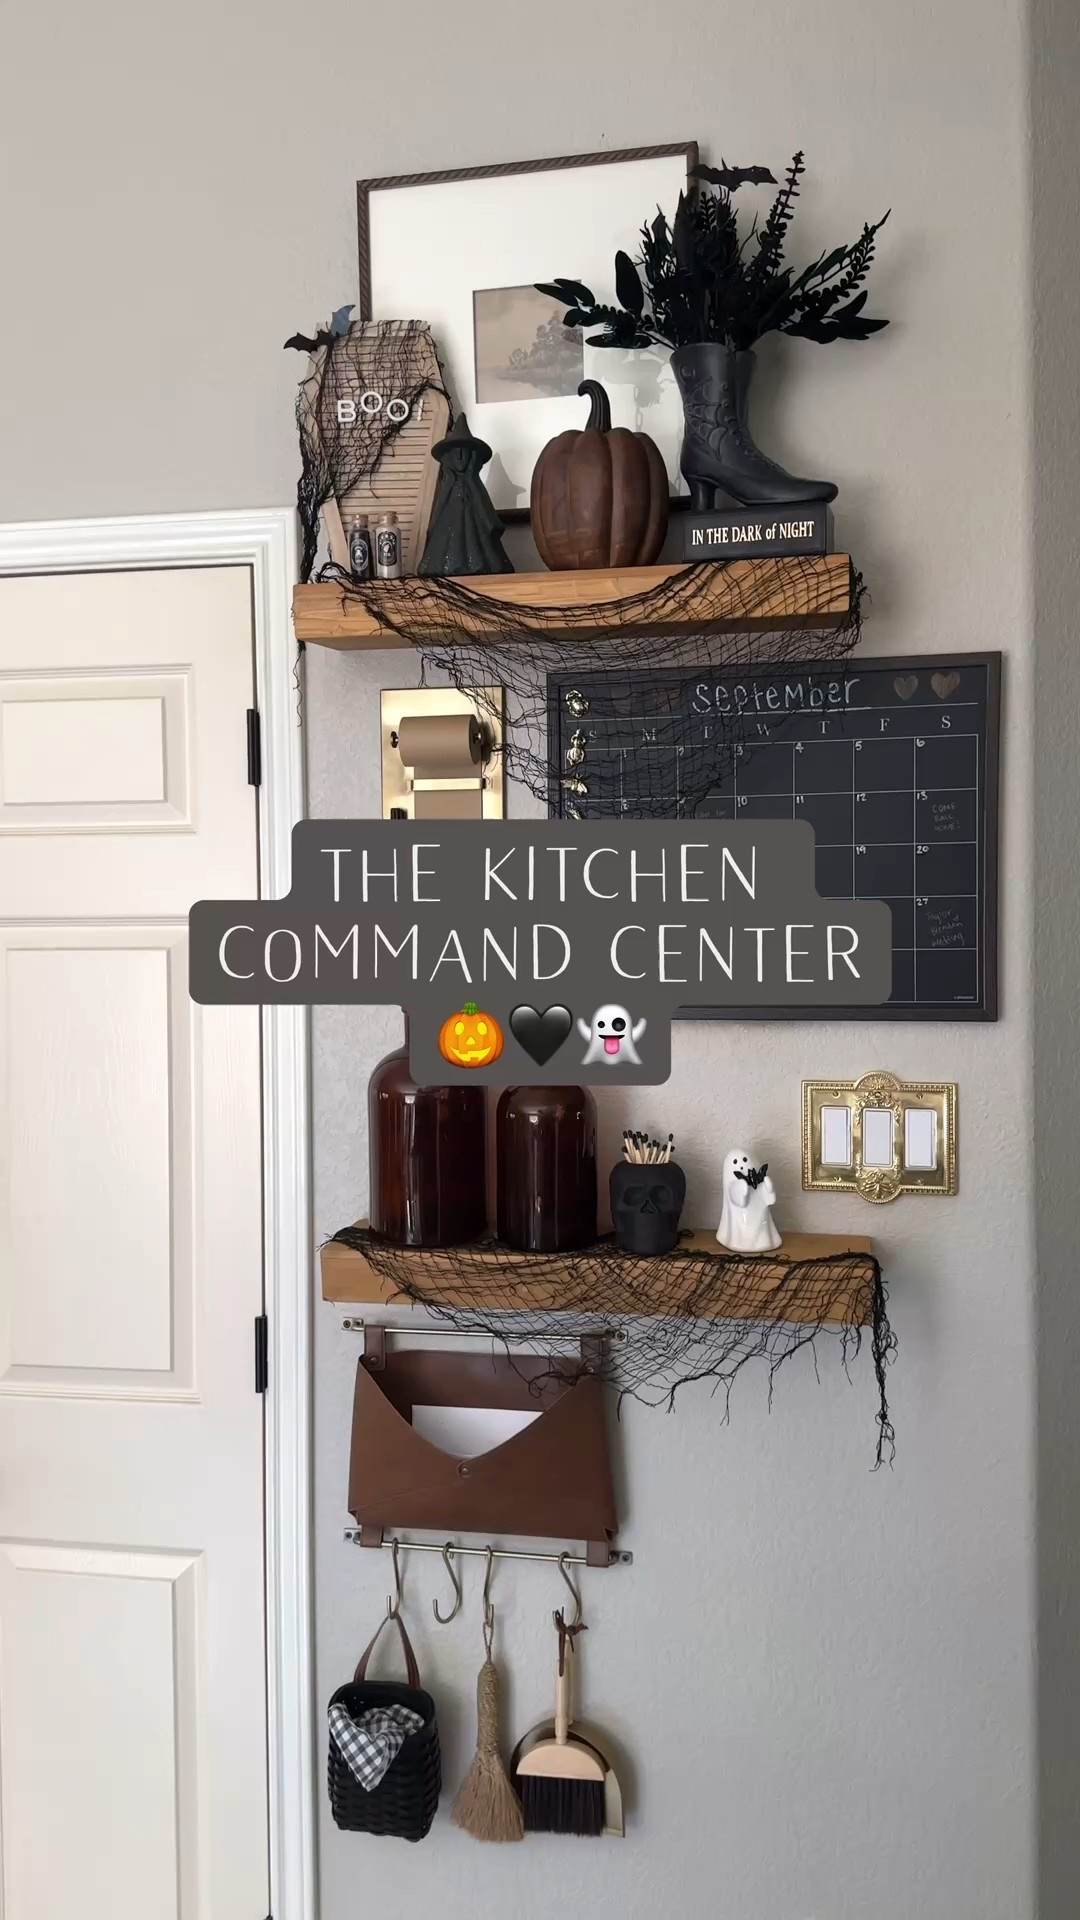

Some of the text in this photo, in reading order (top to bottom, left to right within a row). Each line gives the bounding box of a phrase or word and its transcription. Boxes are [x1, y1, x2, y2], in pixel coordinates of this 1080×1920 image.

[692, 521, 815, 545] IN THE DARK of NIGHT
[692, 677, 860, 714] September
[641, 728, 657, 741] M
[756, 723, 771, 736] W
[818, 720, 830, 734] T
[879, 718, 890, 731] F
[941, 715, 951, 729] S
[795, 742, 804, 753] 4
[855, 741, 863, 751] 5
[916, 738, 925, 747] 6
[737, 796, 748, 807] 10
[796, 795, 804, 804] 11
[856, 793, 867, 802] 12
[917, 791, 928, 801] 13
[856, 845, 929, 855] 19 20
[916, 897, 929, 906] 27
